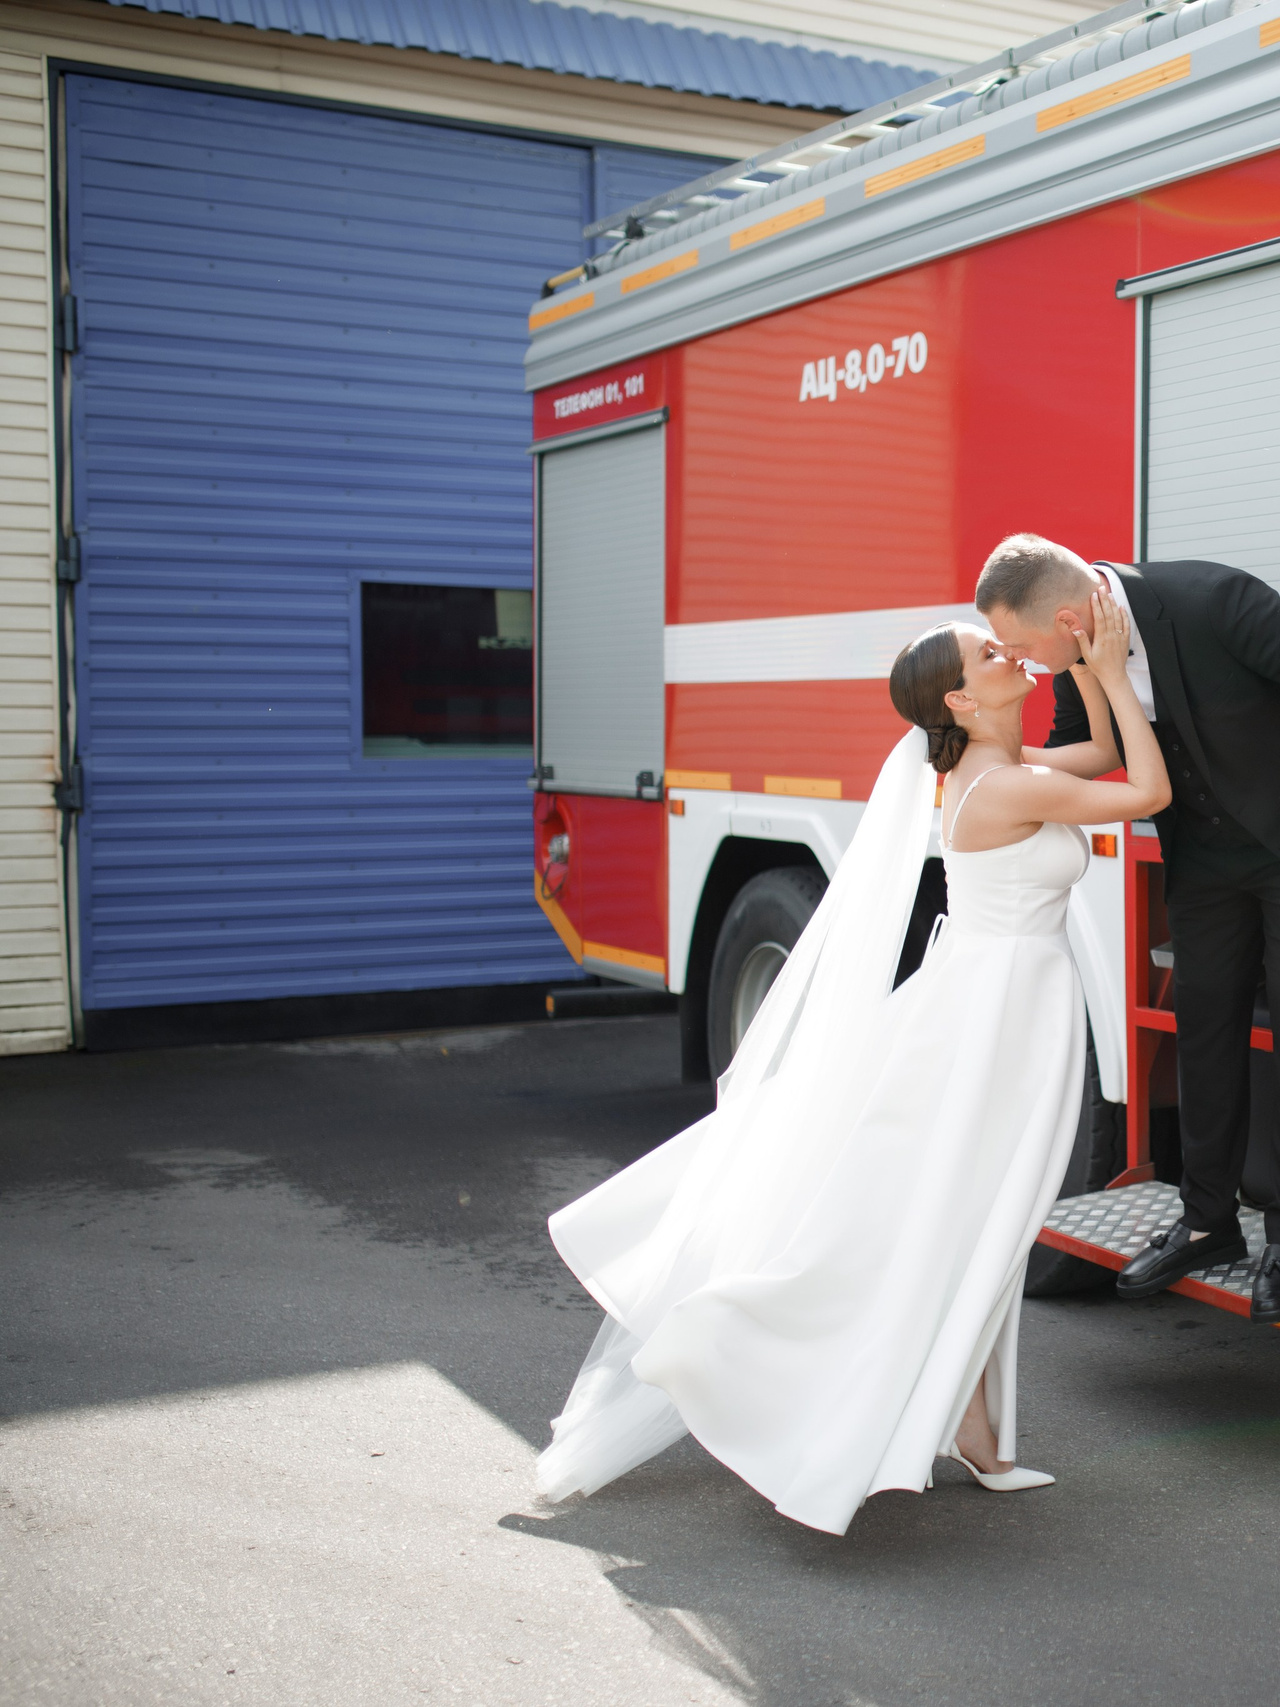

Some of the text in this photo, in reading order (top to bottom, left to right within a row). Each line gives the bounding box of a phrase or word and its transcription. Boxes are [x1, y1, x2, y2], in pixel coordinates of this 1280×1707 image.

[553, 385, 604, 419] ТЕЛЕФОН
[624, 372, 645, 398] 101
[799, 331, 928, 402] АЦ-8,0-70
